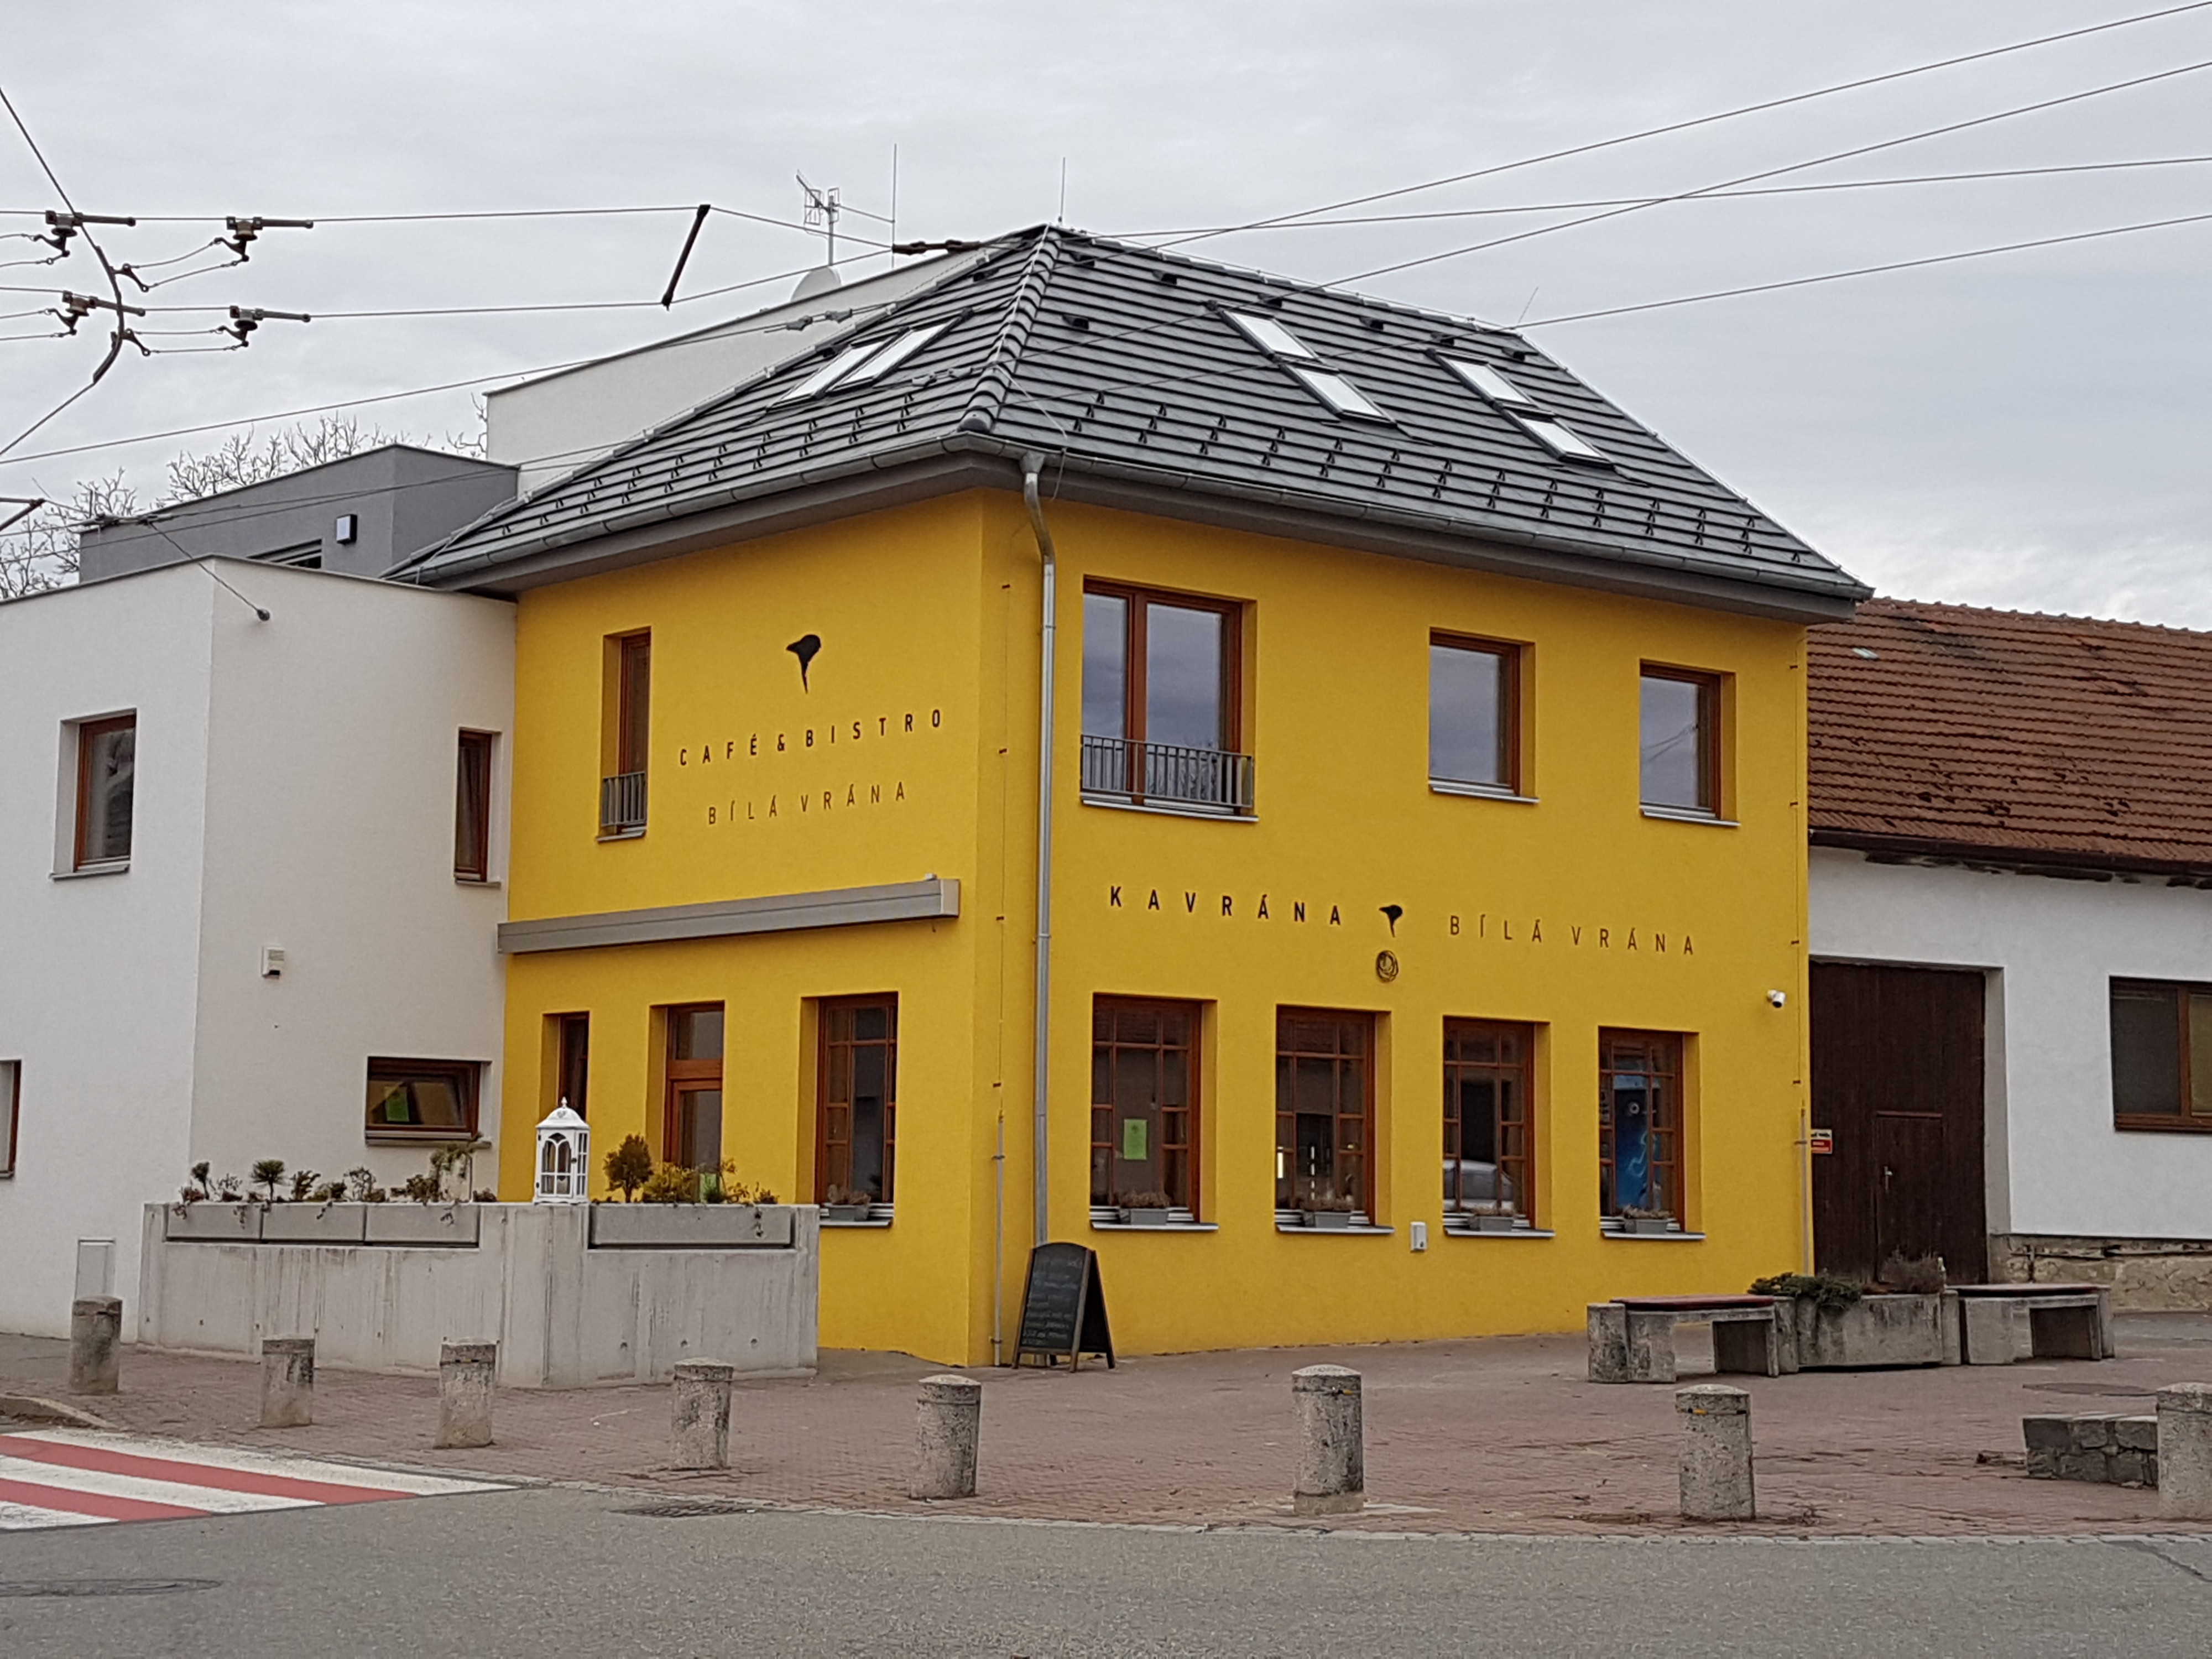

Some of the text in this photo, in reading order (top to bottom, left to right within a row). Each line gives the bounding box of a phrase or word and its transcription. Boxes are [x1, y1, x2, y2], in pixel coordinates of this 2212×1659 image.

[708, 781, 905, 825] BÍLÁ VRÁNA
[1110, 885, 1341, 926] KAVRÁNA
[1450, 914, 1693, 955] BÍLÁ VRÁNA
